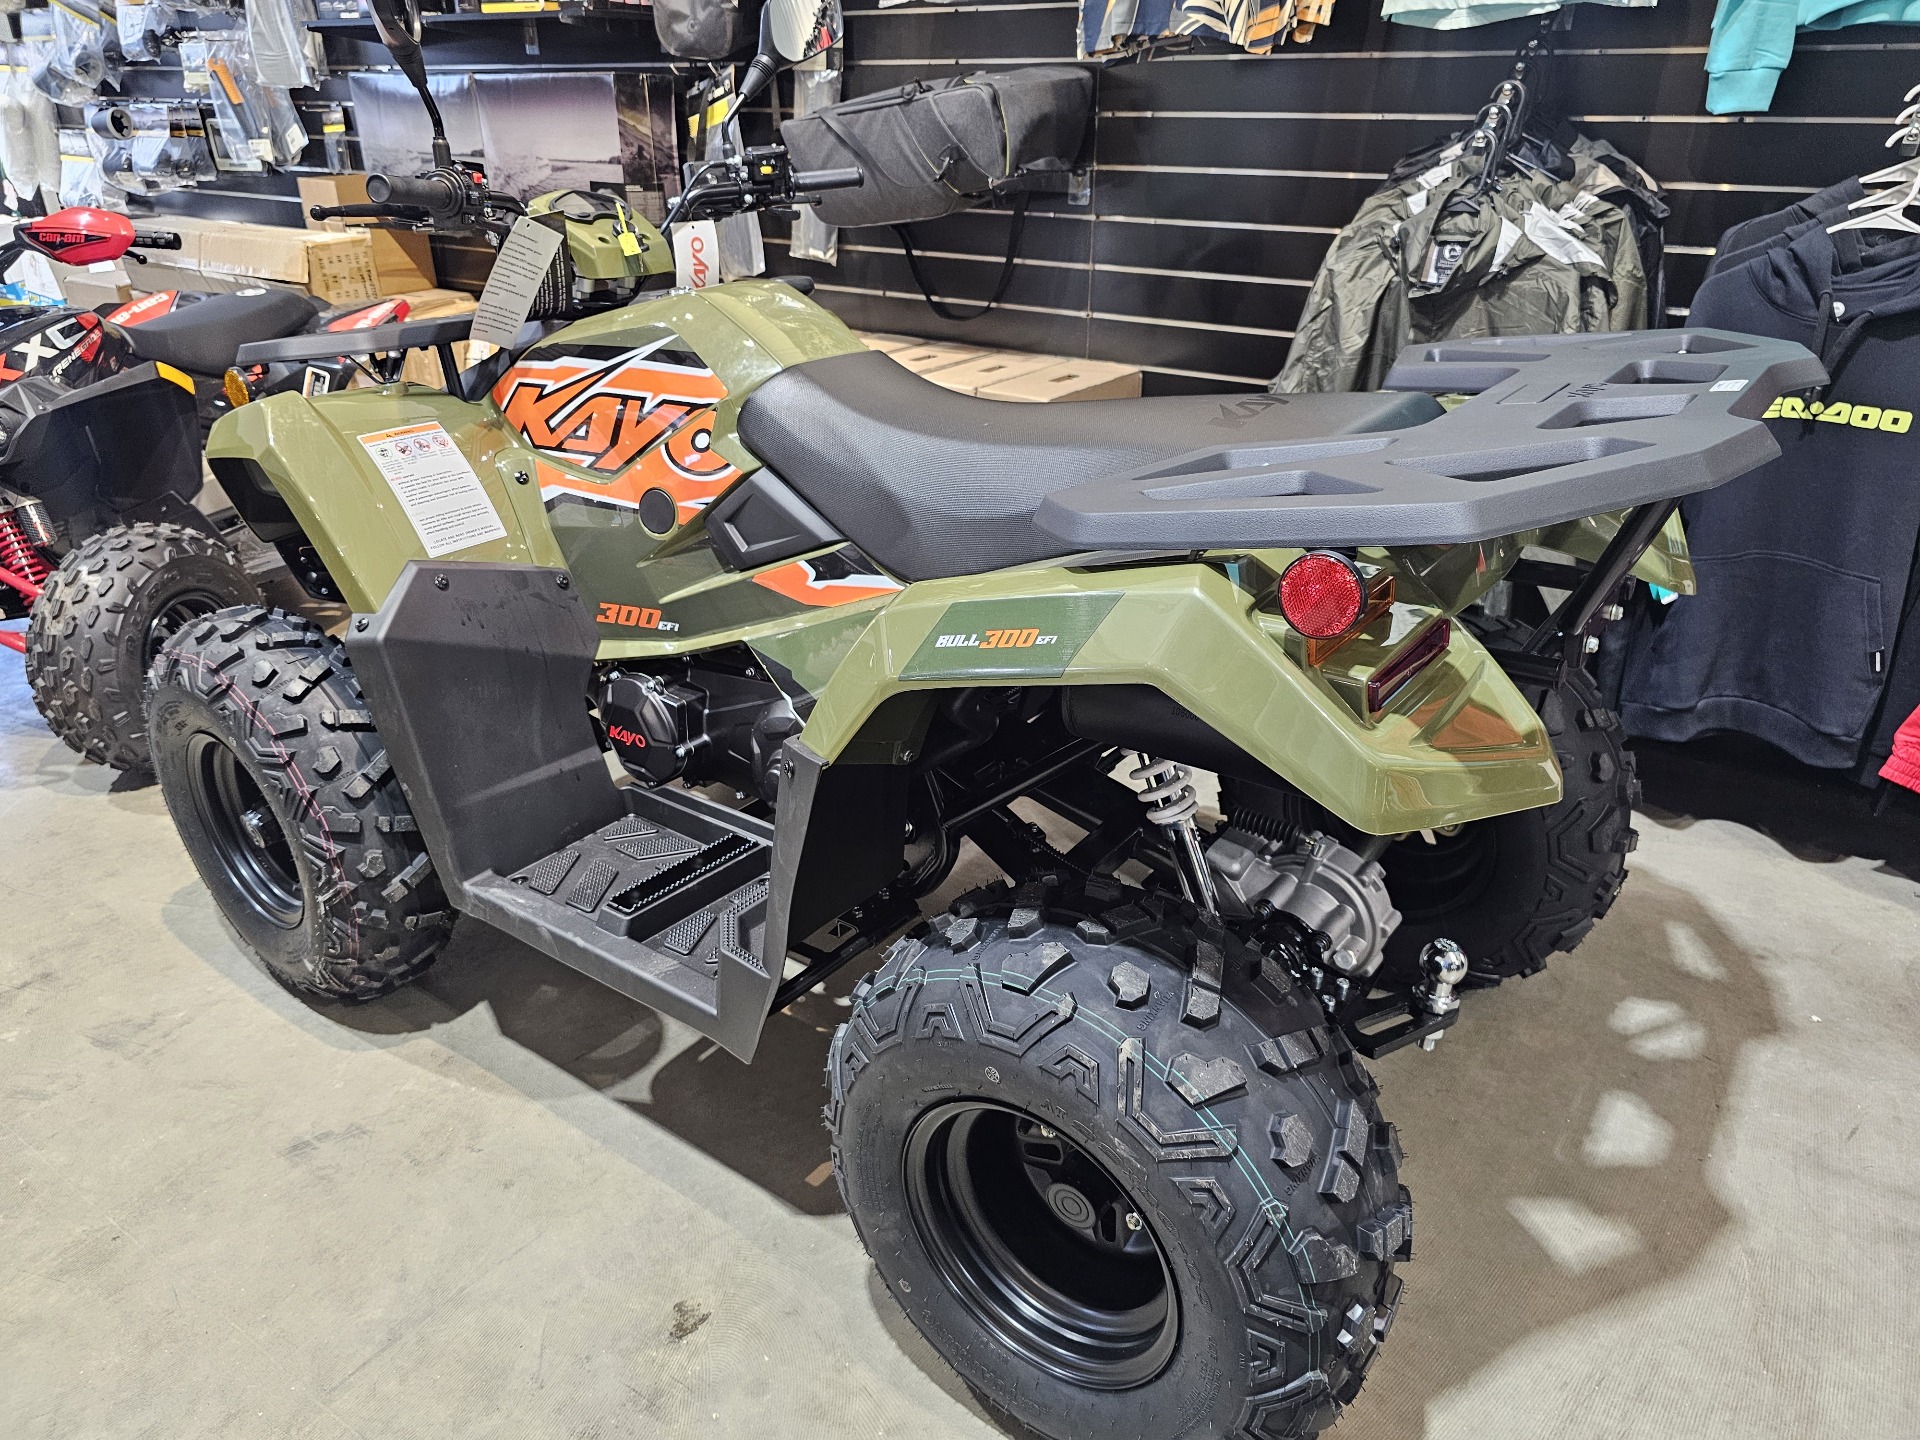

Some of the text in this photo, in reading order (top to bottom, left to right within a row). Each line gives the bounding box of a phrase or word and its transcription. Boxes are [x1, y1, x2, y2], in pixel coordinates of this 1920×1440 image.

[39, 231, 86, 244] can-am
[52, 328, 102, 377] RENEGADE
[504, 371, 730, 476] KAYO
[596, 602, 680, 632] 300 EFI
[935, 628, 1059, 649] BULL 300 EFI
[609, 724, 646, 748] KAYO
